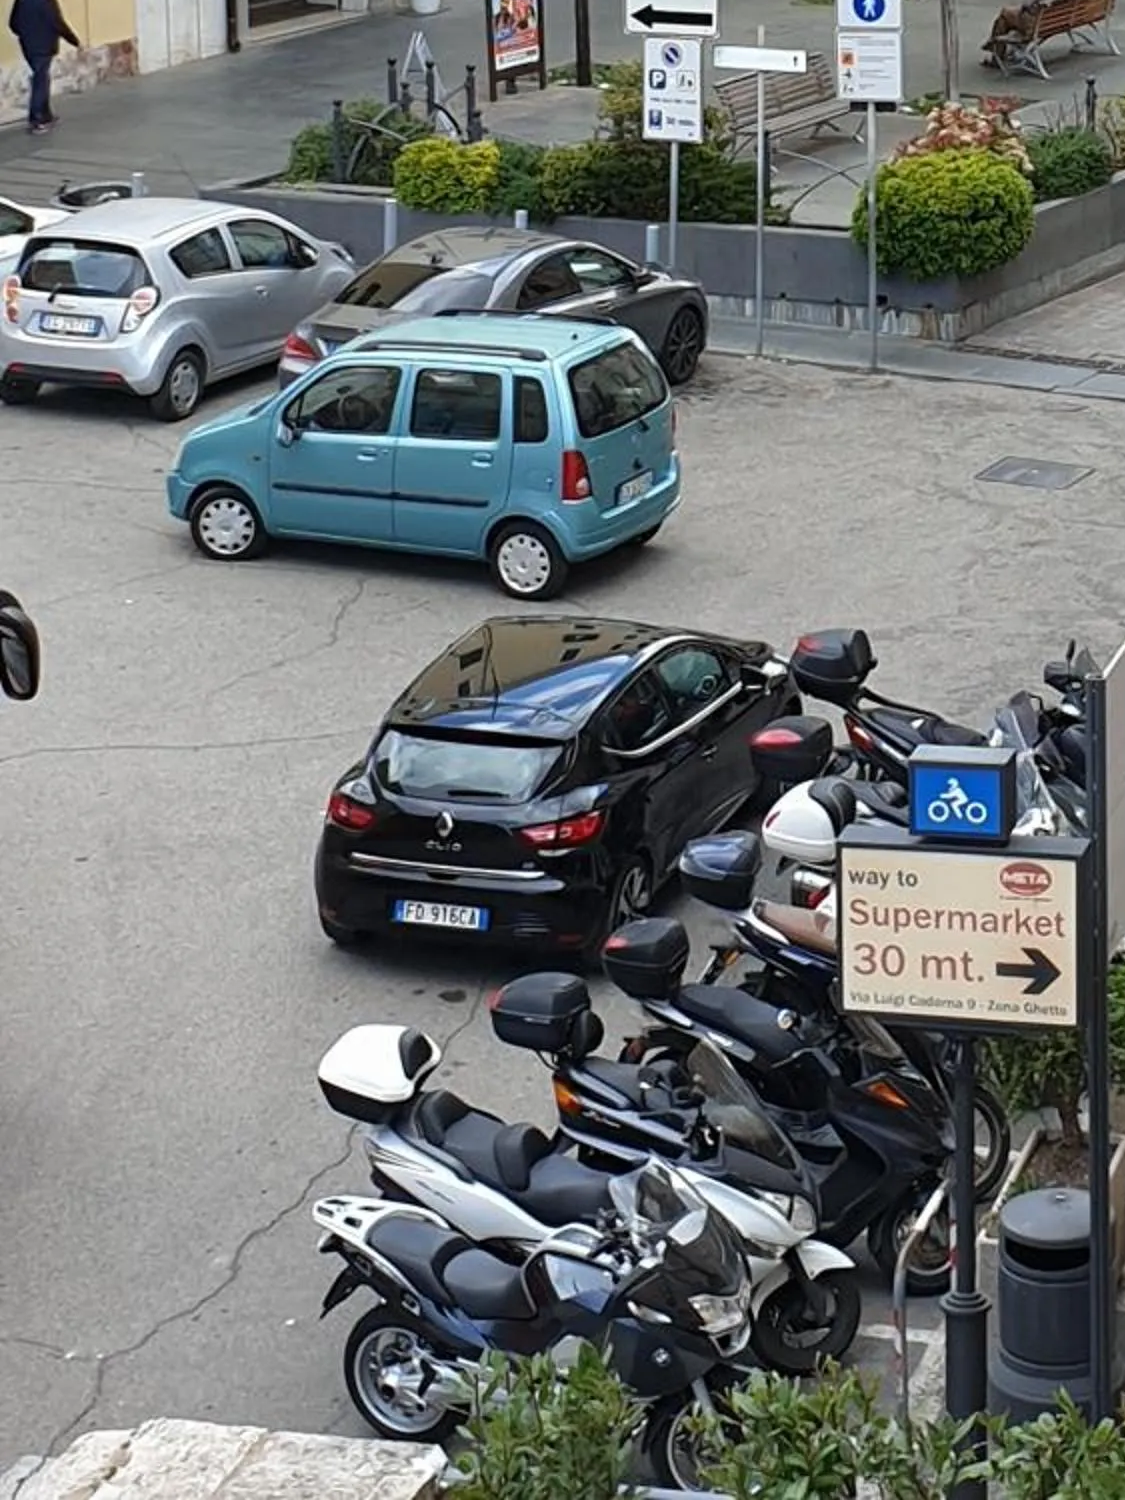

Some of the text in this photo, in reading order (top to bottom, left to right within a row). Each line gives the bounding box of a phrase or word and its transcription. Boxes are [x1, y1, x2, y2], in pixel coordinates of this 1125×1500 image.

[848, 868, 890, 888] way
[897, 870, 918, 888] to
[849, 899, 1067, 938] Supermarket
[852, 942, 986, 984] 30 mt.
[849, 991, 871, 1004] Via
[873, 993, 905, 1008] Luigi
